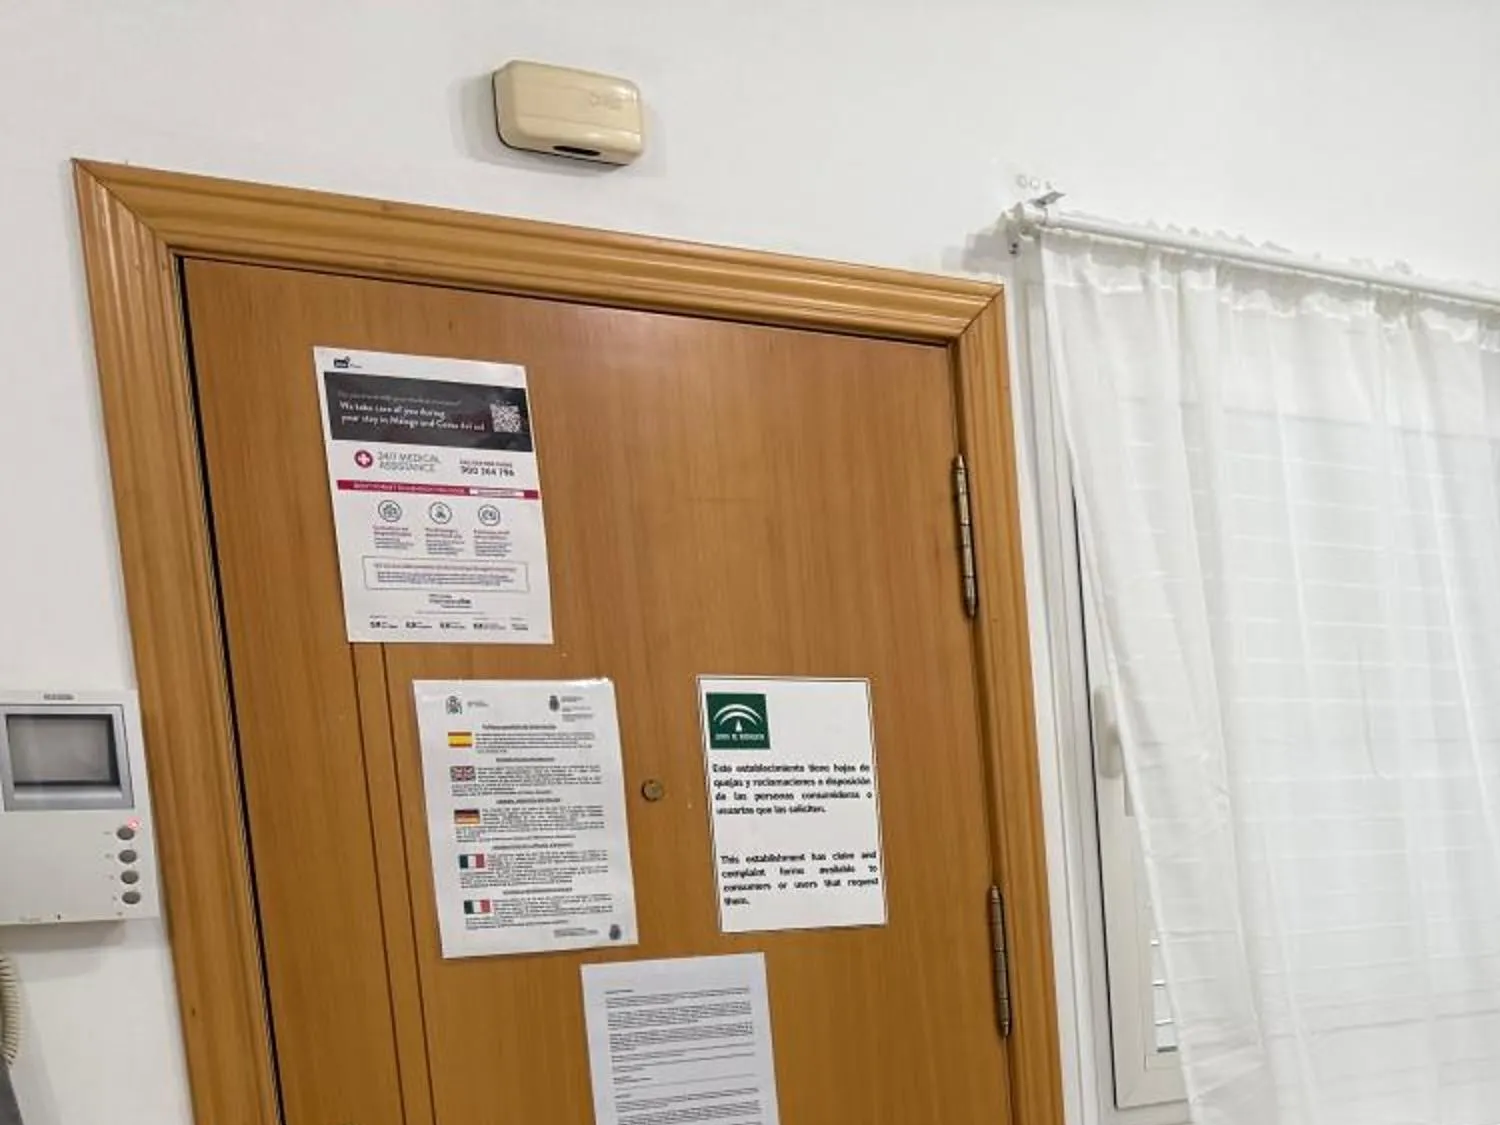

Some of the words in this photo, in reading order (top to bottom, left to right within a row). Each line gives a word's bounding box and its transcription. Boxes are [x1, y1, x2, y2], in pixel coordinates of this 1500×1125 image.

[735, 763, 805, 773] establecimiento
[833, 763, 856, 774] hojas
[713, 778, 743, 788] quejas
[733, 791, 747, 801] las
[754, 792, 794, 802] personas
[756, 805, 772, 816] que
[773, 804, 787, 814] las
[720, 855, 740, 864] This
[745, 853, 806, 863] establishment
[811, 852, 827, 861] has
[861, 851, 877, 860] and
[722, 868, 766, 879] complaint
[794, 880, 818, 889] users
[824, 878, 841, 887] that
